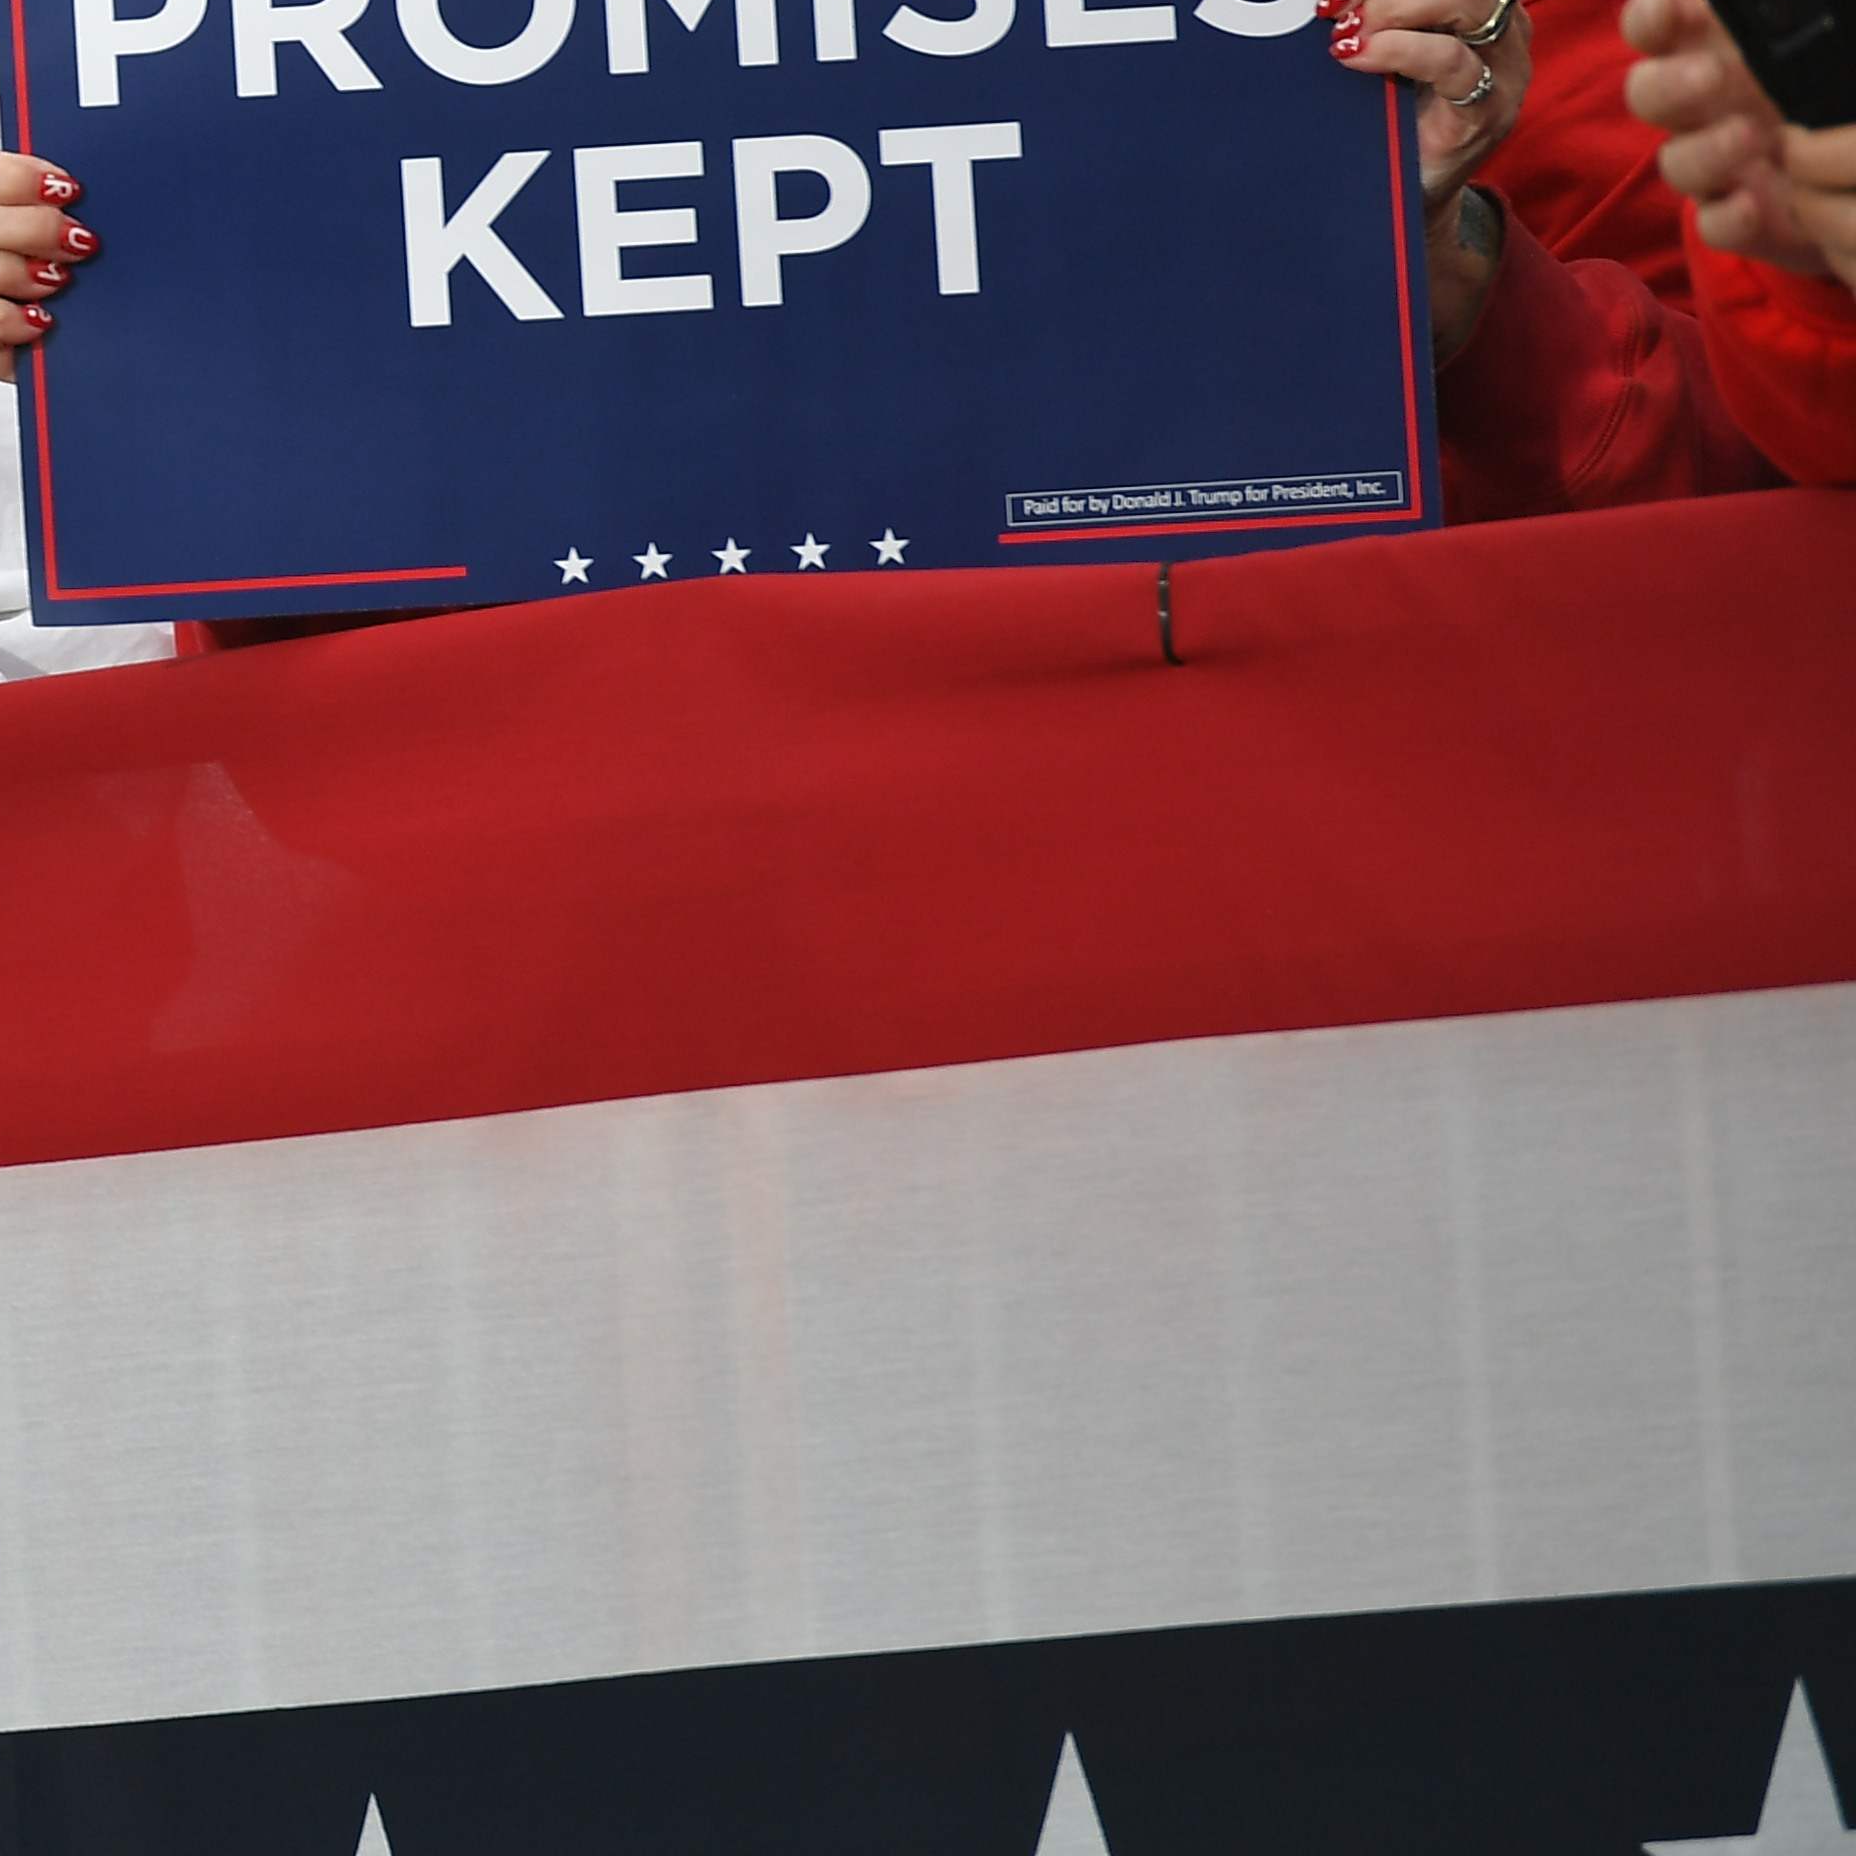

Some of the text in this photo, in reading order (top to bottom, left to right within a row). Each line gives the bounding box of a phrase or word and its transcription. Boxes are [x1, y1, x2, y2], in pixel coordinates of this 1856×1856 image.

[400, 119, 1025, 329] KEPT
[1023, 479, 1387, 517] Paid for by Donald J. Trump for President, Inc.
